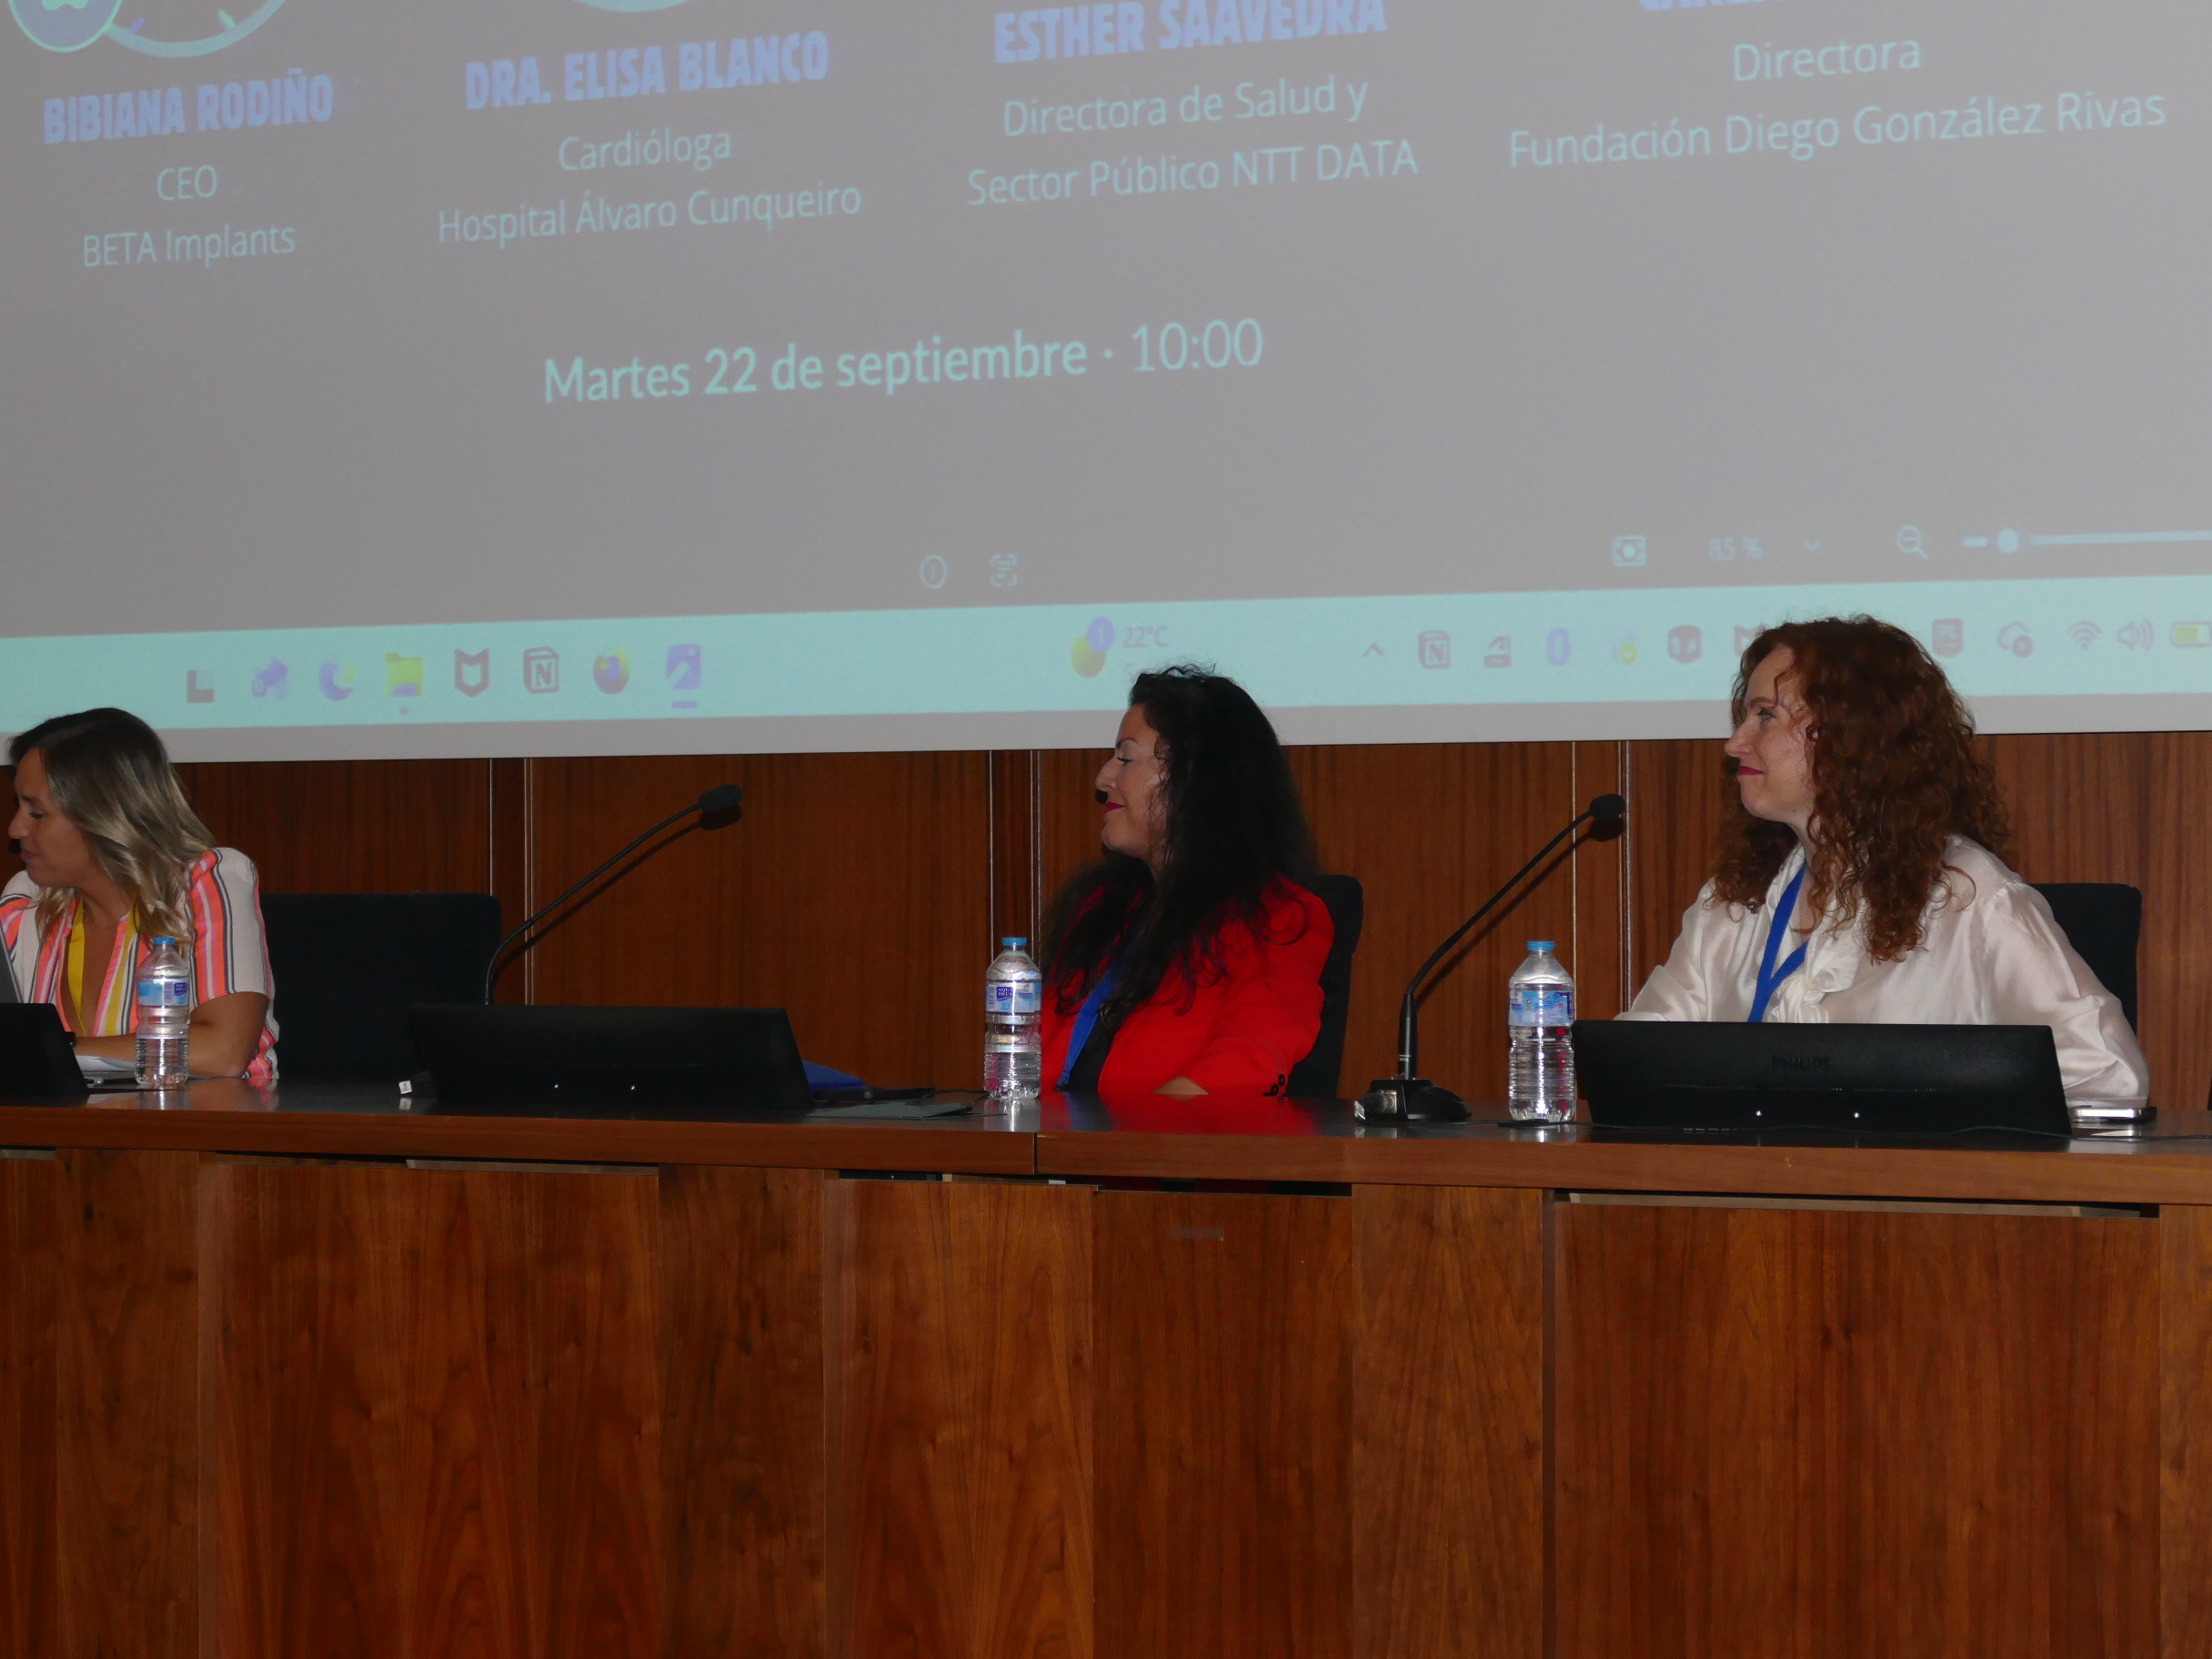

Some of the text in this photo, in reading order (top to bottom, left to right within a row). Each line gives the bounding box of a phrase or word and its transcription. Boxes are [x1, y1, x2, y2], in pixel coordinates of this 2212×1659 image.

[993, 0, 1388, 64] ESTHER SAAVEDRA
[1734, 39, 1922, 82] Directora
[465, 31, 830, 110] DRA. ELISA BLANCO
[43, 67, 335, 145] BIBIANA RODIÑO
[1003, 75, 1370, 136] Directora de Salud y
[1509, 90, 2167, 167] Fundación Diego González Rivas
[558, 127, 733, 172] Cardióloga
[968, 139, 1420, 206] Sector Público NTT DATA
[156, 165, 219, 201] CEO
[83, 224, 297, 269] BETA Implants
[438, 182, 862, 250] Hospital Álvaro Cunqueiro
[544, 317, 1265, 403] Martes 22 de septiembre 10:00
[1709, 538, 1735, 560] 85
[1772, 1056, 1830, 1071] PHILIPS
